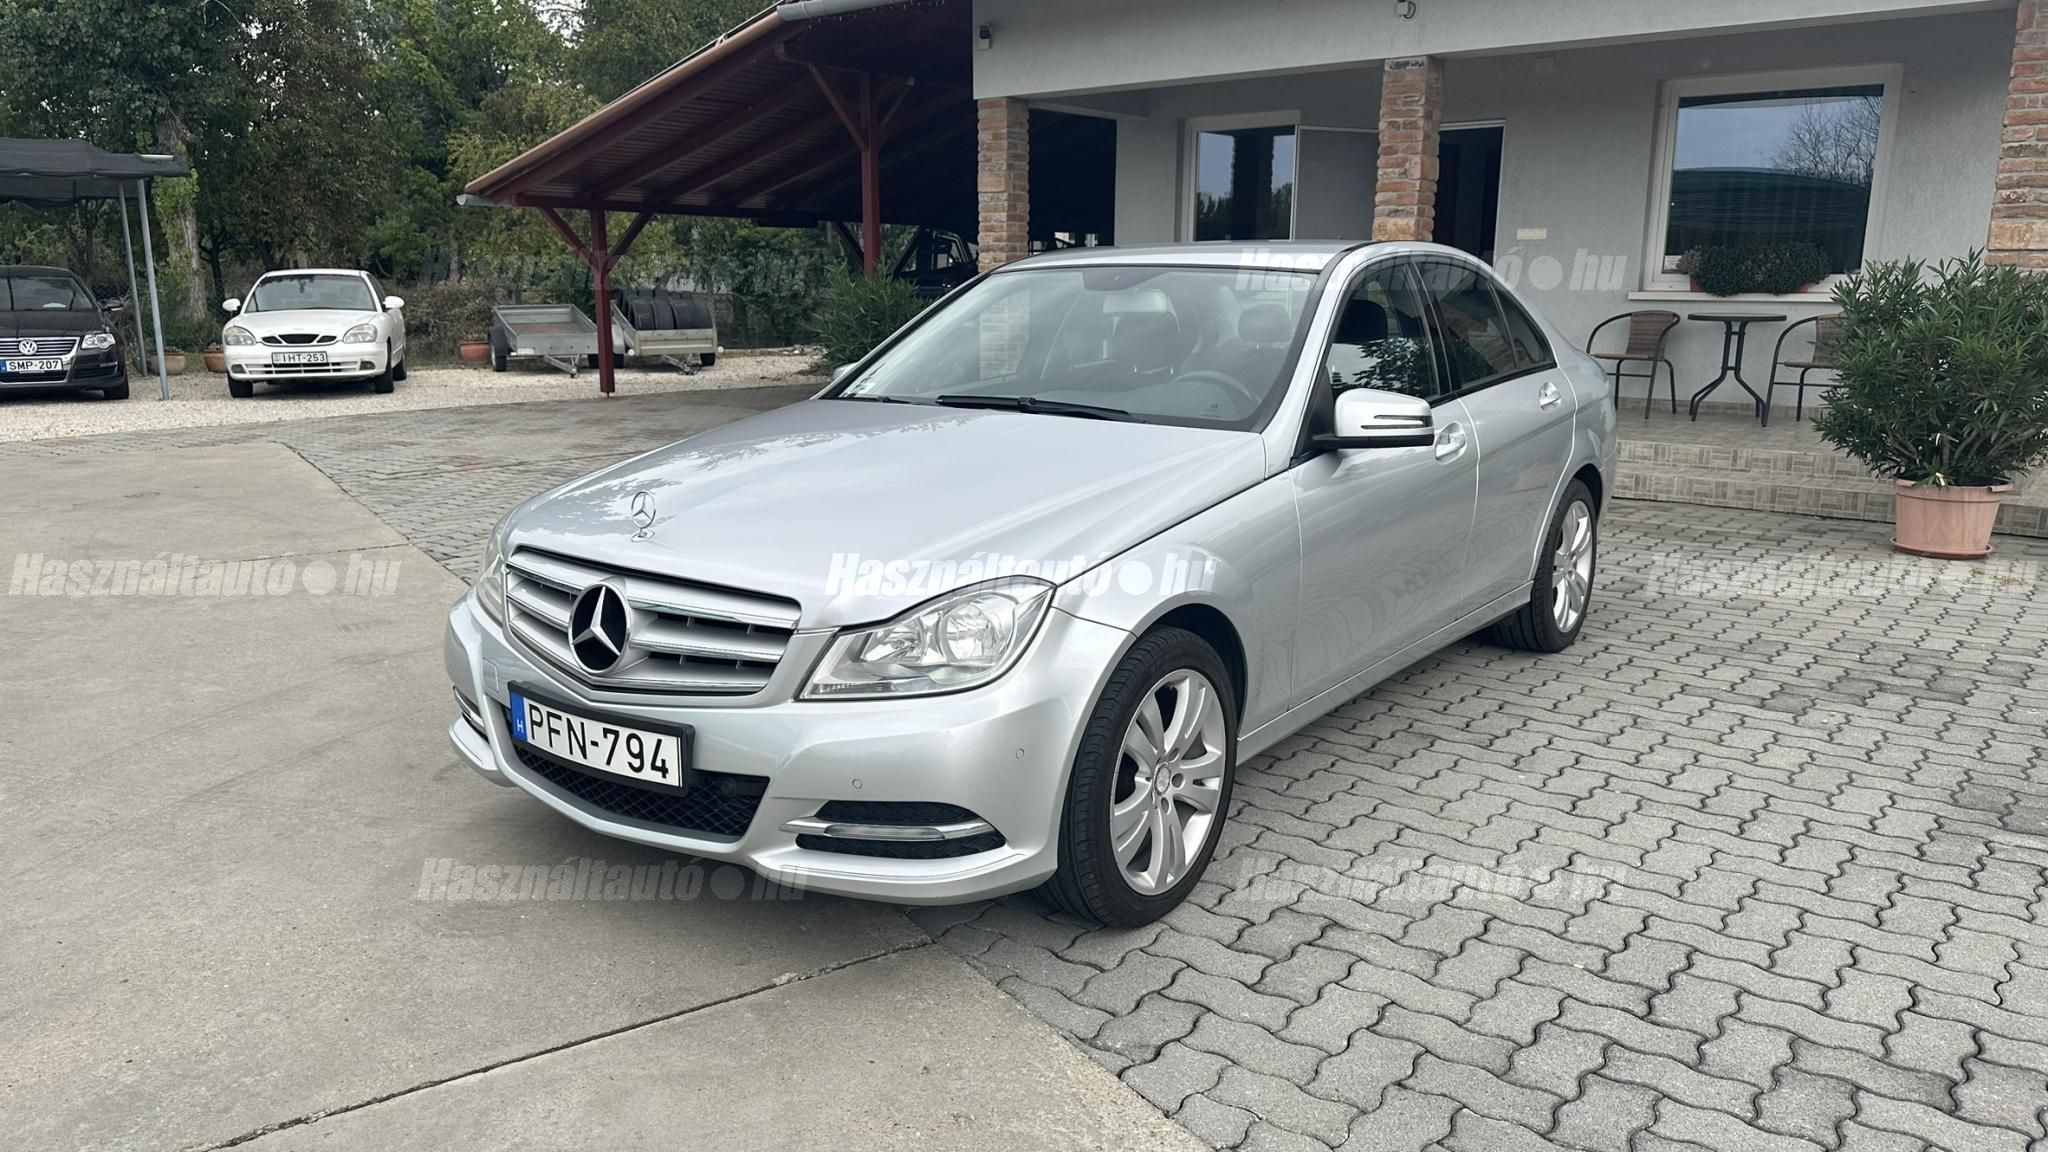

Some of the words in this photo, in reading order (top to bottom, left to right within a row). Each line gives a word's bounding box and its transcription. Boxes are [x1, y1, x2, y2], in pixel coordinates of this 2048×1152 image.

[283, 353, 325, 363] IHT-253
[9, 360, 59, 371] SMP-207
[516, 719, 525, 734] H
[528, 703, 669, 780] PFN-794
